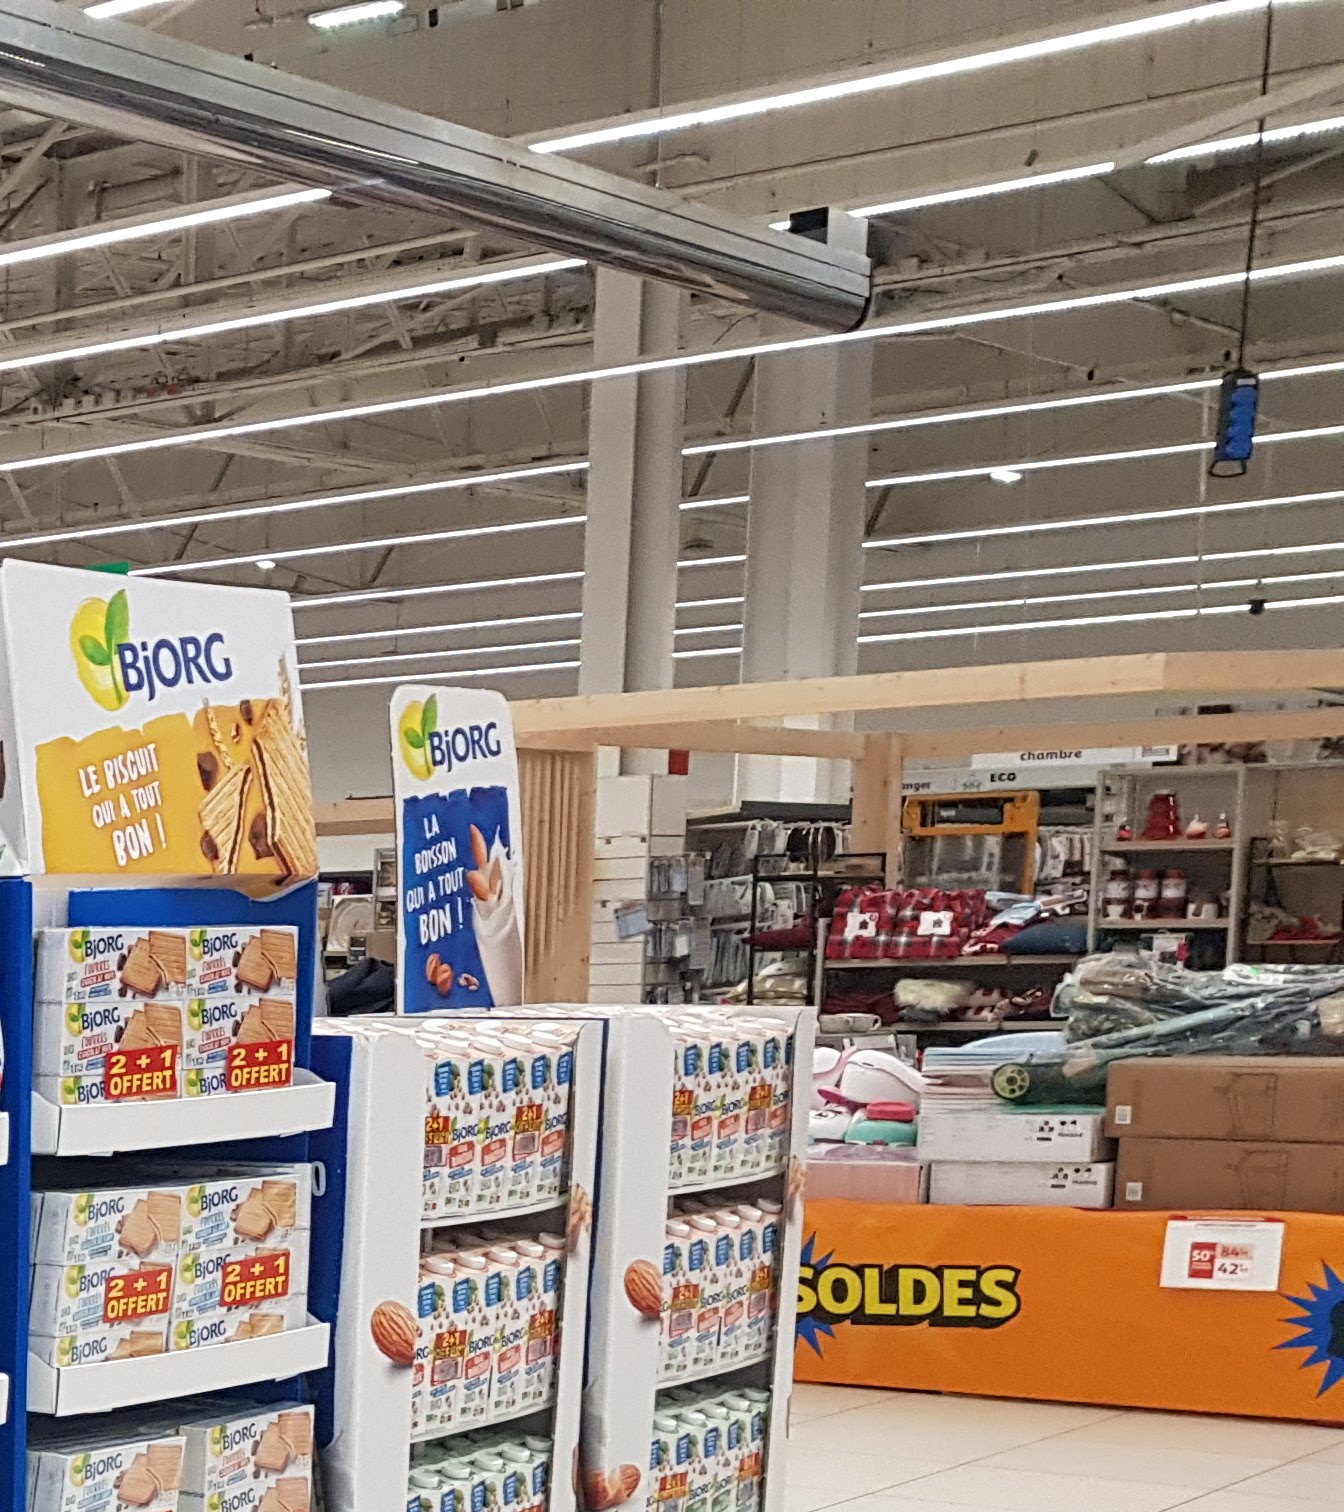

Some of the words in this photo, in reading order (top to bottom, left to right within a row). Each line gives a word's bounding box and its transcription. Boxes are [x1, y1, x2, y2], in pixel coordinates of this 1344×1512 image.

[79, 767, 100, 796] LE
[104, 743, 156, 788] BISCUIT
[1020, 749, 1082, 761] chambre
[93, 799, 116, 829] QUI
[119, 794, 130, 822] A
[134, 781, 161, 815] TOUT
[424, 813, 440, 840] LA
[112, 822, 151, 868] BON
[415, 837, 457, 875] BOISSON
[406, 887, 424, 913] QUI
[428, 883, 436, 901] A
[439, 867, 464, 896] TOUT
[419, 907, 452, 945] BON
[230, 1048, 247, 1066] 2
[277, 1043, 288, 1061] 1
[109, 1070, 173, 1095] OFFERT
[231, 1062, 289, 1087] OFFERT
[107, 1290, 168, 1319] OFFERT
[223, 1276, 286, 1303] OFFERT
[797, 1265, 1019, 1322] SOLDES
